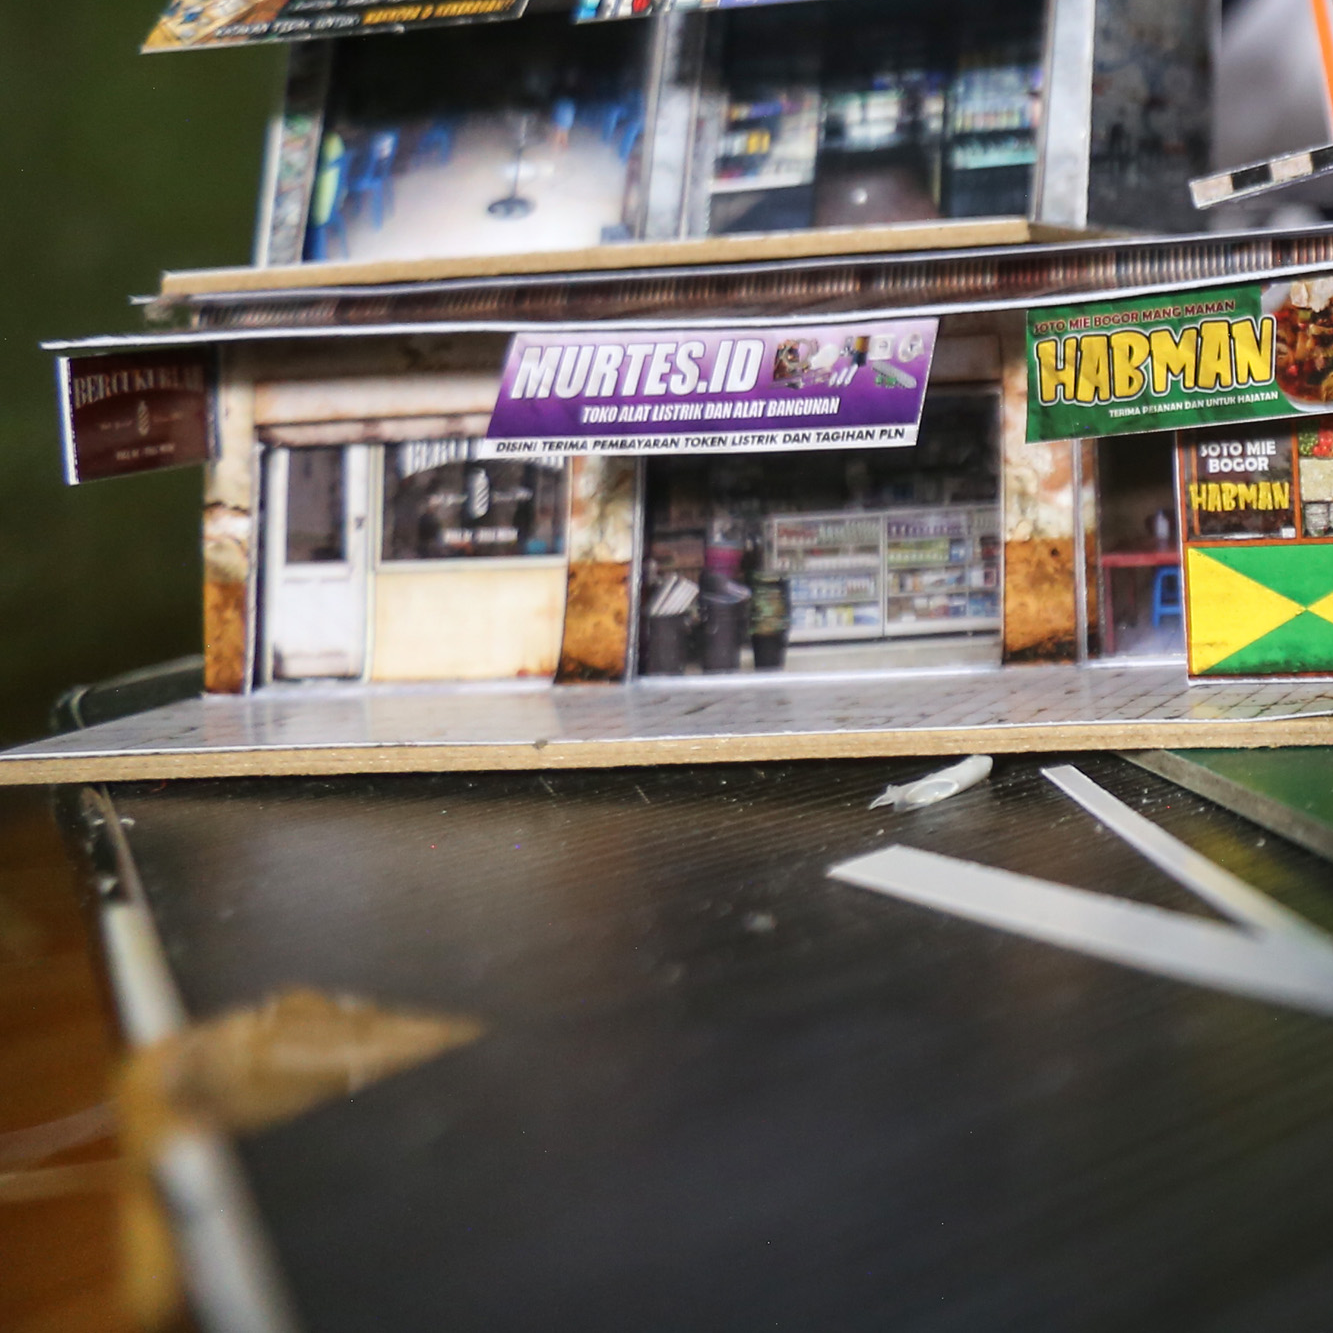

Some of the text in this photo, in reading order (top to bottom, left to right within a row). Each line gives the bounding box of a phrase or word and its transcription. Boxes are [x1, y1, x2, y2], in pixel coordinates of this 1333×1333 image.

[1034, 300, 1235, 335] SOTO MIE BOGOR MANG MAMAN
[510, 338, 766, 400] MURTES.ID
[1034, 316, 1277, 407] HABMAN
[582, 397, 841, 425] TOKO ALAT LISTRIK DAN ALAT BANGUNAN
[1109, 390, 1279, 419] TERIMA PESANAN DAN UNTUK HAJATAN
[496, 427, 905, 453] DISINI TERIMA PEMBAYARAN TOKEN LISTRIK DAN TAGIHAN PLN
[1200, 439, 1277, 457] SOTO MIE
[1208, 456, 1269, 474] BOGOR
[1189, 481, 1290, 512] HABMAN
